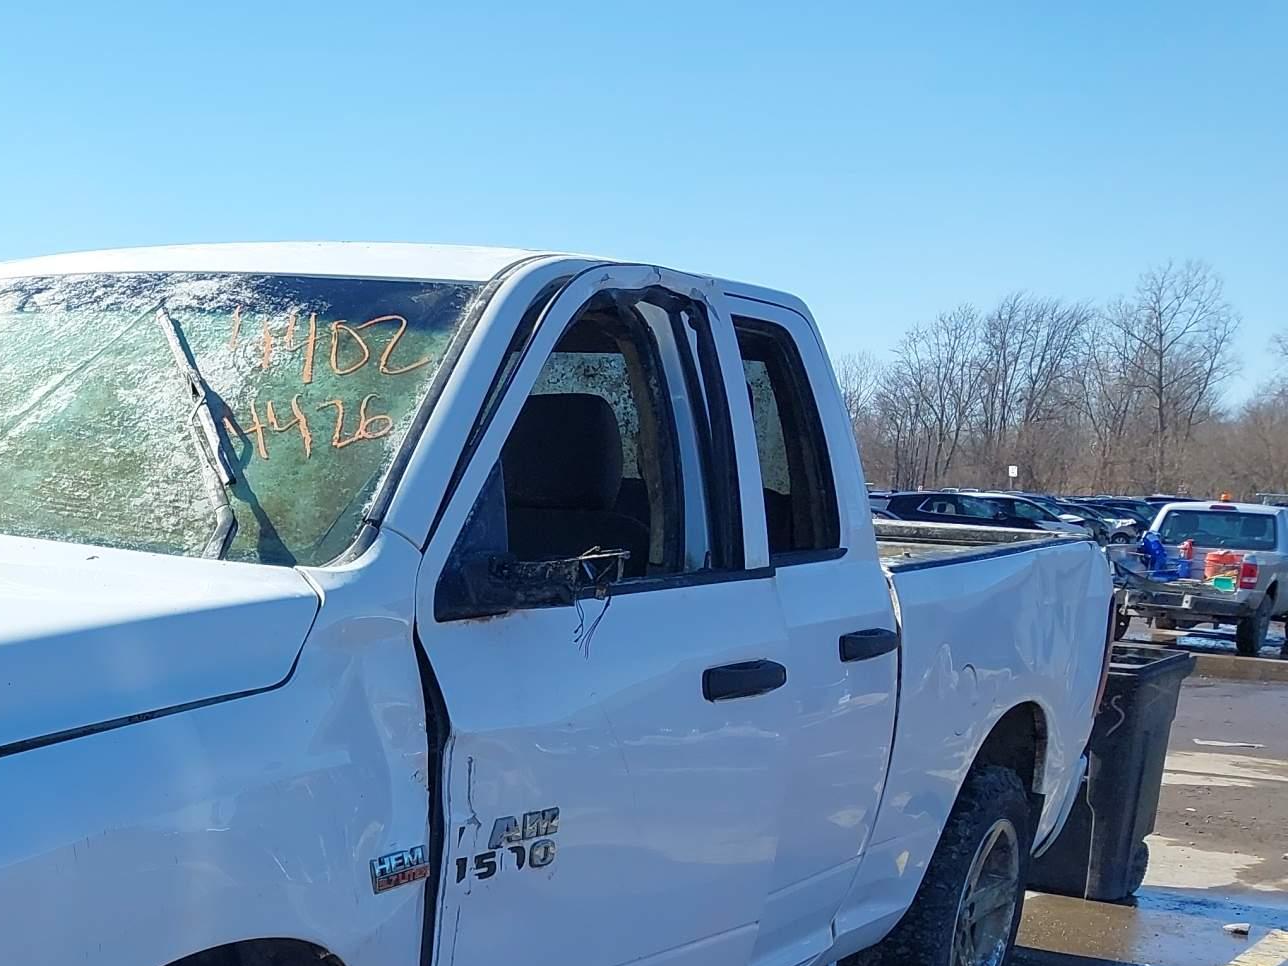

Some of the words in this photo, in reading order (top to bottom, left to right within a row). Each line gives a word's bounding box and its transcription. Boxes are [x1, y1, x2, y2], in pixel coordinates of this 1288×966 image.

[222, 393, 394, 461] 4426
[457, 806, 560, 850] AM
[373, 845, 426, 877] HEM
